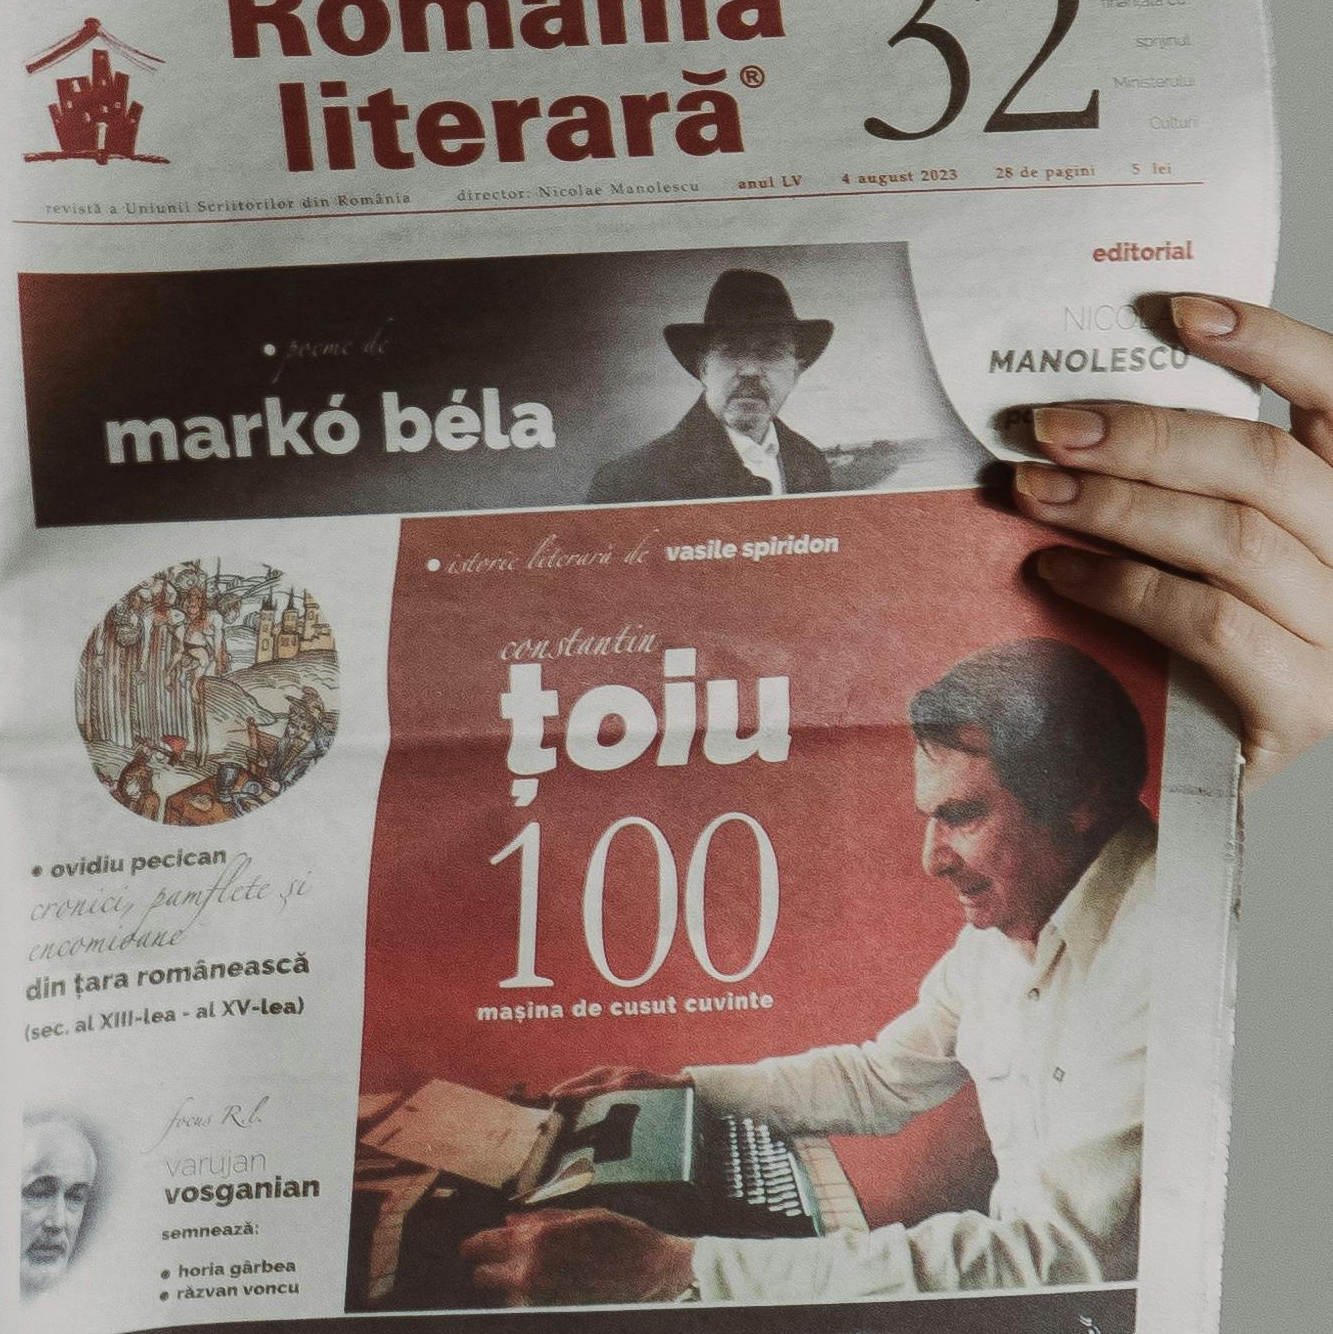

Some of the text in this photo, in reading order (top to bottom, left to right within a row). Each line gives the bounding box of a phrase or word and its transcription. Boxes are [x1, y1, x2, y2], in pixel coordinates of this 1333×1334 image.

[738, 175, 802, 190] anul LV
[841, 169, 959, 186] 4 august 2023
[996, 164, 1096, 181] 28 de pagini
[1131, 162, 1172, 175] 5 lei
[46, 192, 411, 215] revistă a Uniunii Scriitorilor din România
[457, 180, 699, 202] director: Nicolae Manolescu
[1093, 240, 1194, 262] editorial
[989, 346, 1191, 373] MANOLESCU
[104, 387, 557, 466] markó béla
[665, 537, 739, 562] vasile
[741, 533, 839, 562] spiridon
[499, 623, 658, 661] constantin
[499, 647, 791, 807] țoiu
[51, 846, 228, 879] ovidiu pecican
[488, 811, 780, 989] 100
[25, 951, 311, 1001] din țara românească
[24, 1021, 70, 1042] (sec.
[74, 1016, 95, 1035] al
[100, 1007, 177, 1031] XIII-lea
[196, 1004, 215, 1019] al
[221, 996, 306, 1019] XV-lea)
[476, 990, 774, 1025] mașina de cusut cuvinte
[140, 1095, 212, 1154] focus
[165, 1149, 268, 1180] varujan
[164, 1174, 321, 1208] vosganian
[161, 1220, 260, 1242] semnează:
[178, 1257, 297, 1282] horia gârbea
[177, 1281, 300, 1301] răzvan voncu
